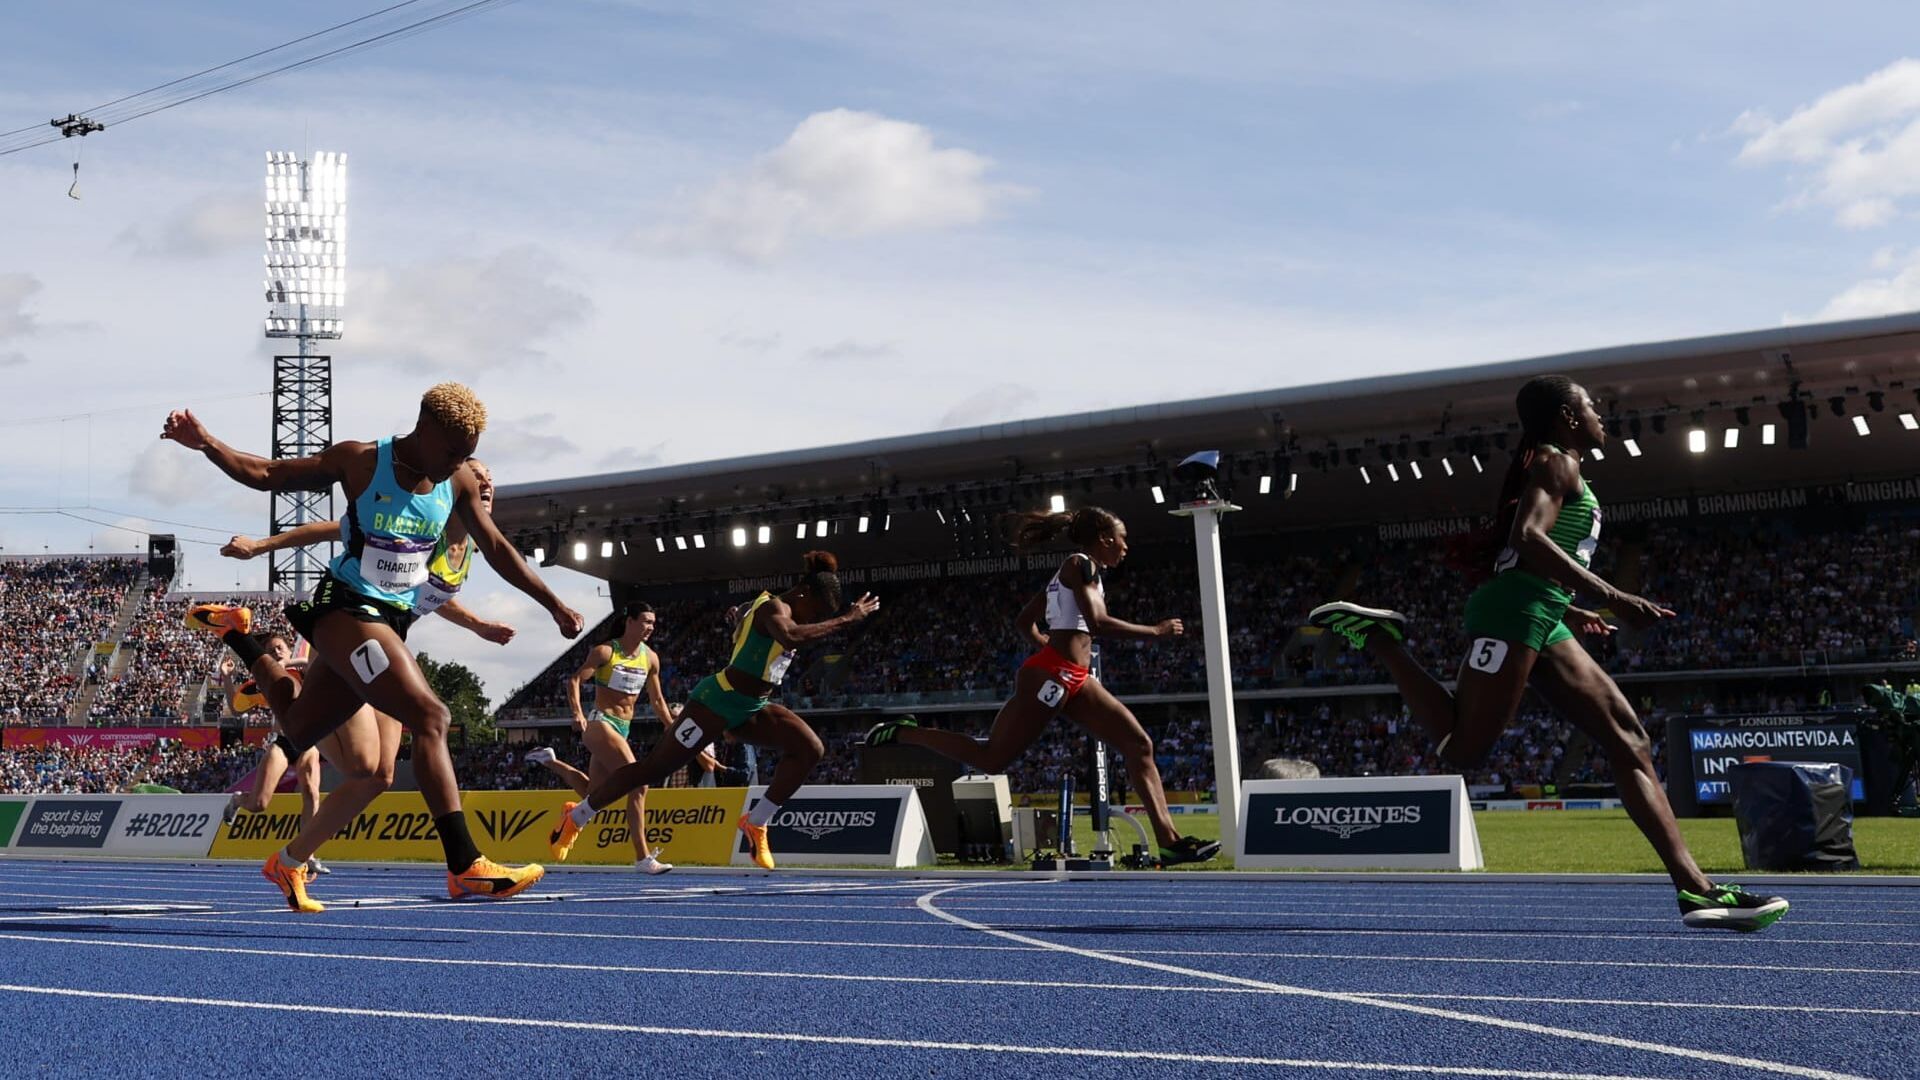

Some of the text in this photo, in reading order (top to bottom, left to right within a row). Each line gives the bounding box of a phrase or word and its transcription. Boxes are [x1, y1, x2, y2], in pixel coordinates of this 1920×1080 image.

[1602, 498, 1688, 522] RMINGHAM
[1699, 488, 1806, 515] BIRMINGHAM
[1378, 518, 1470, 541] BIRMINGHAM
[871, 563, 941, 582] BIRMINGHAM
[947, 557, 1020, 576] BIRMINGHAM
[728, 573, 793, 594] BIRMINGHAM
[356, 645, 375, 676] 7
[1477, 641, 1496, 666] 5
[1044, 685, 1058, 702] 3
[1739, 716, 1803, 727] LONGINES
[681, 726, 697, 742] 4
[1694, 730, 1855, 749] NARANGOLINTEVIDA A
[885, 778, 934, 787] LONGINES
[41, 810, 103, 824] sport is just
[586, 806, 725, 825] mmnwealth
[767, 811, 876, 827] LONGINES
[1274, 805, 1421, 825] LONGINES
[30, 822, 102, 838] the beginning
[125, 813, 209, 838] #B2022
[228, 813, 379, 840] BIRMINAM
[597, 827, 673, 848] gaes
